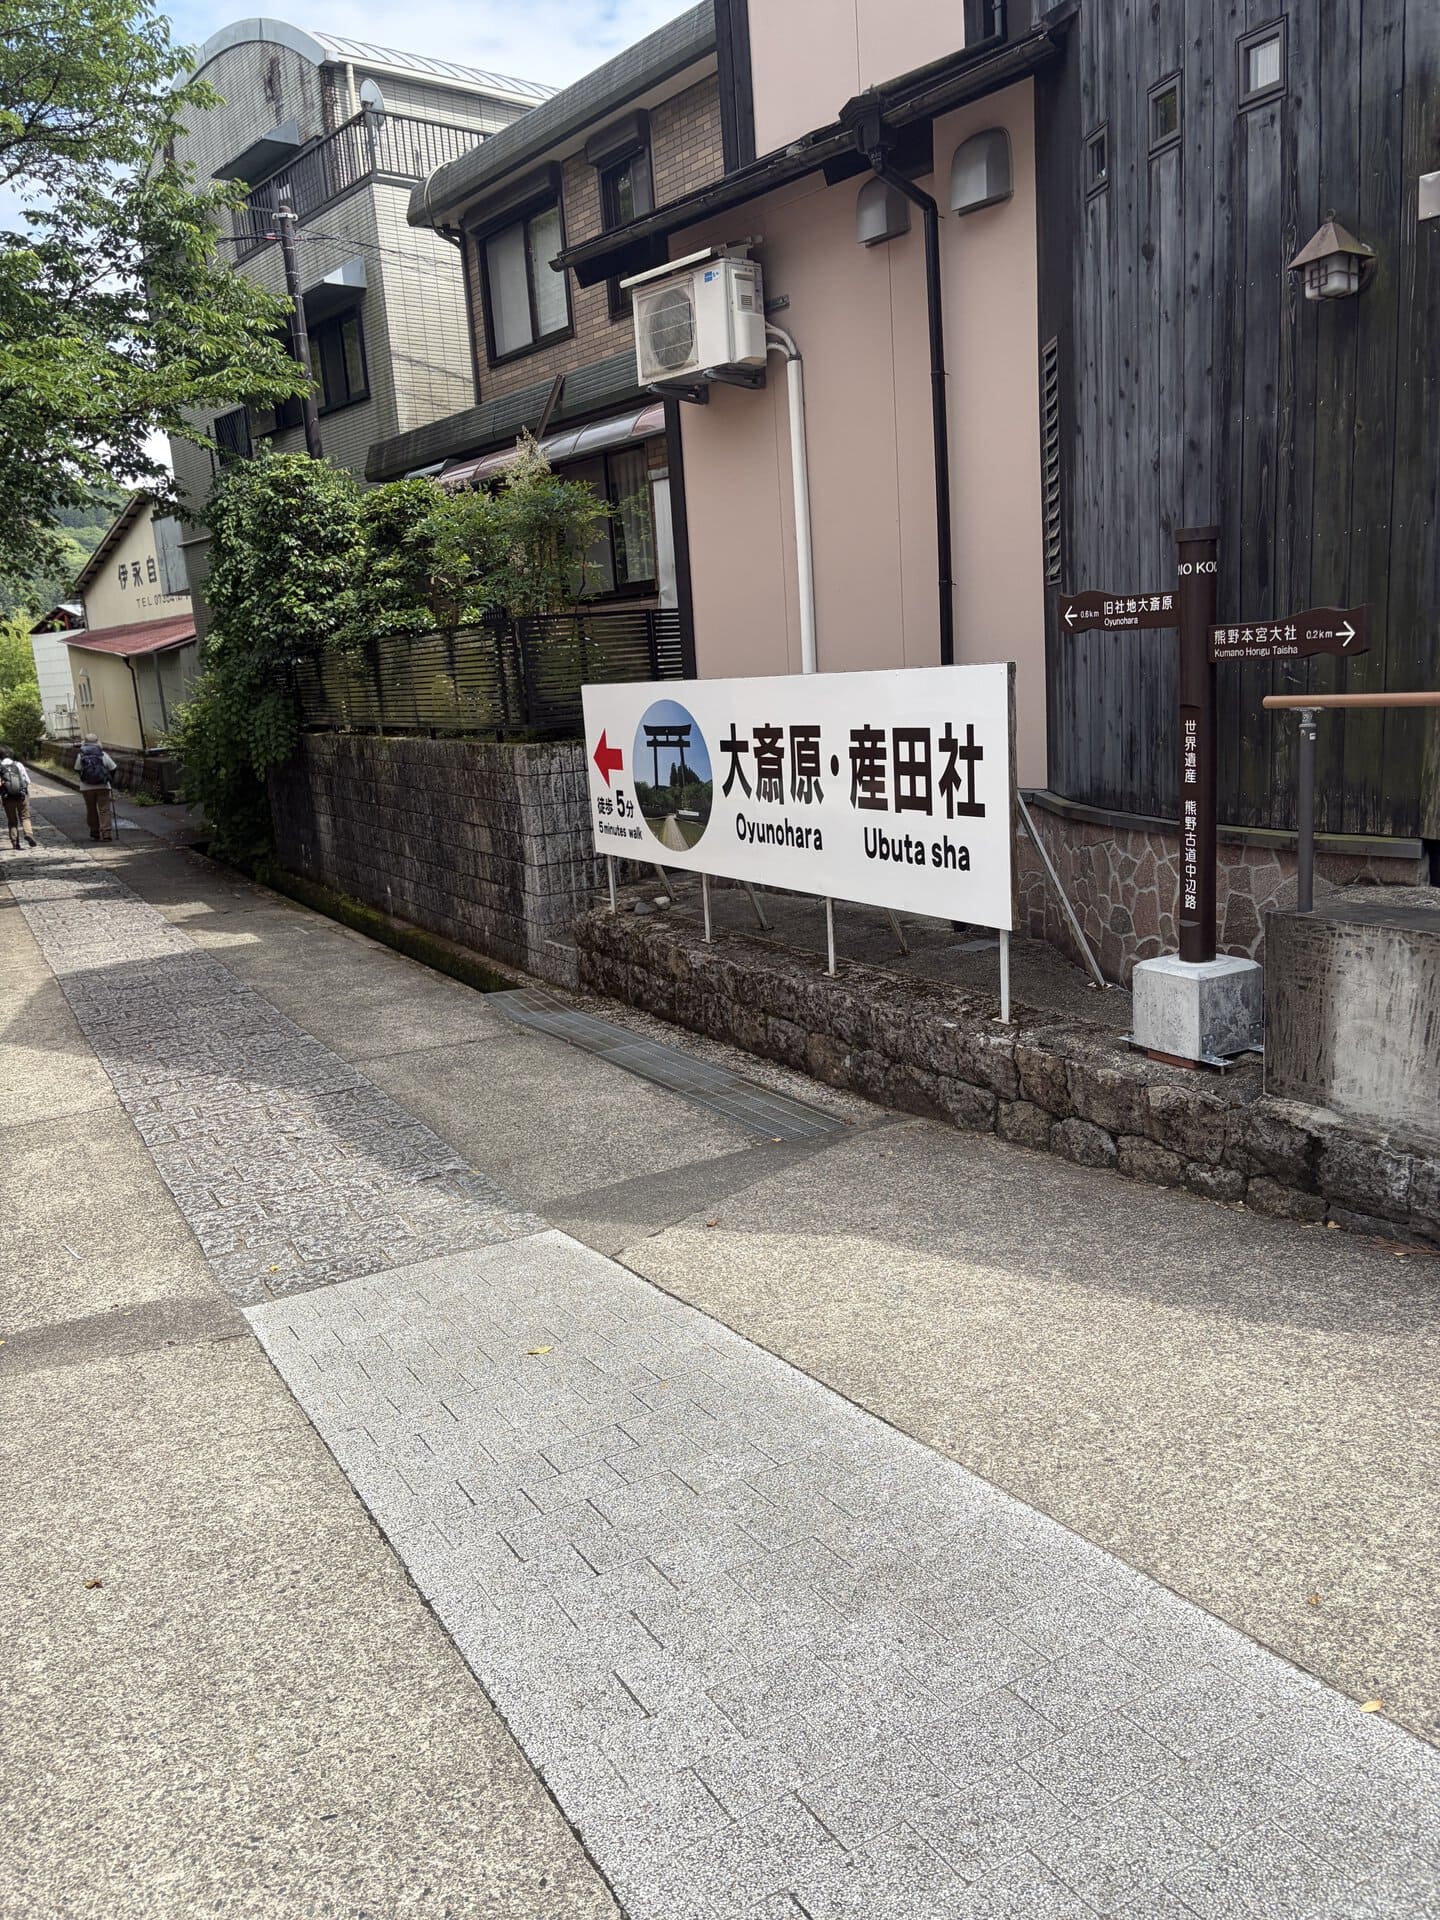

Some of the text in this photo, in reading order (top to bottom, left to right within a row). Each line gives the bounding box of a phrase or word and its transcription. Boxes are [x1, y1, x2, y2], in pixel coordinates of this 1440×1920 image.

[136, 596, 152, 608] TEL
[1103, 595, 1173, 615] 旧社地大斎原
[1104, 616, 1139, 627] Oyunohara
[1214, 625, 1298, 645] 熊野本宮大社
[1214, 645, 1298, 658] Kumano Hongu Taisha
[1184, 719, 1197, 910] 世界遺産 熊野古道中辺路
[598, 820, 643, 840] 5 minutes walk
[736, 812, 971, 872] Oyunohara Ubuta sha
